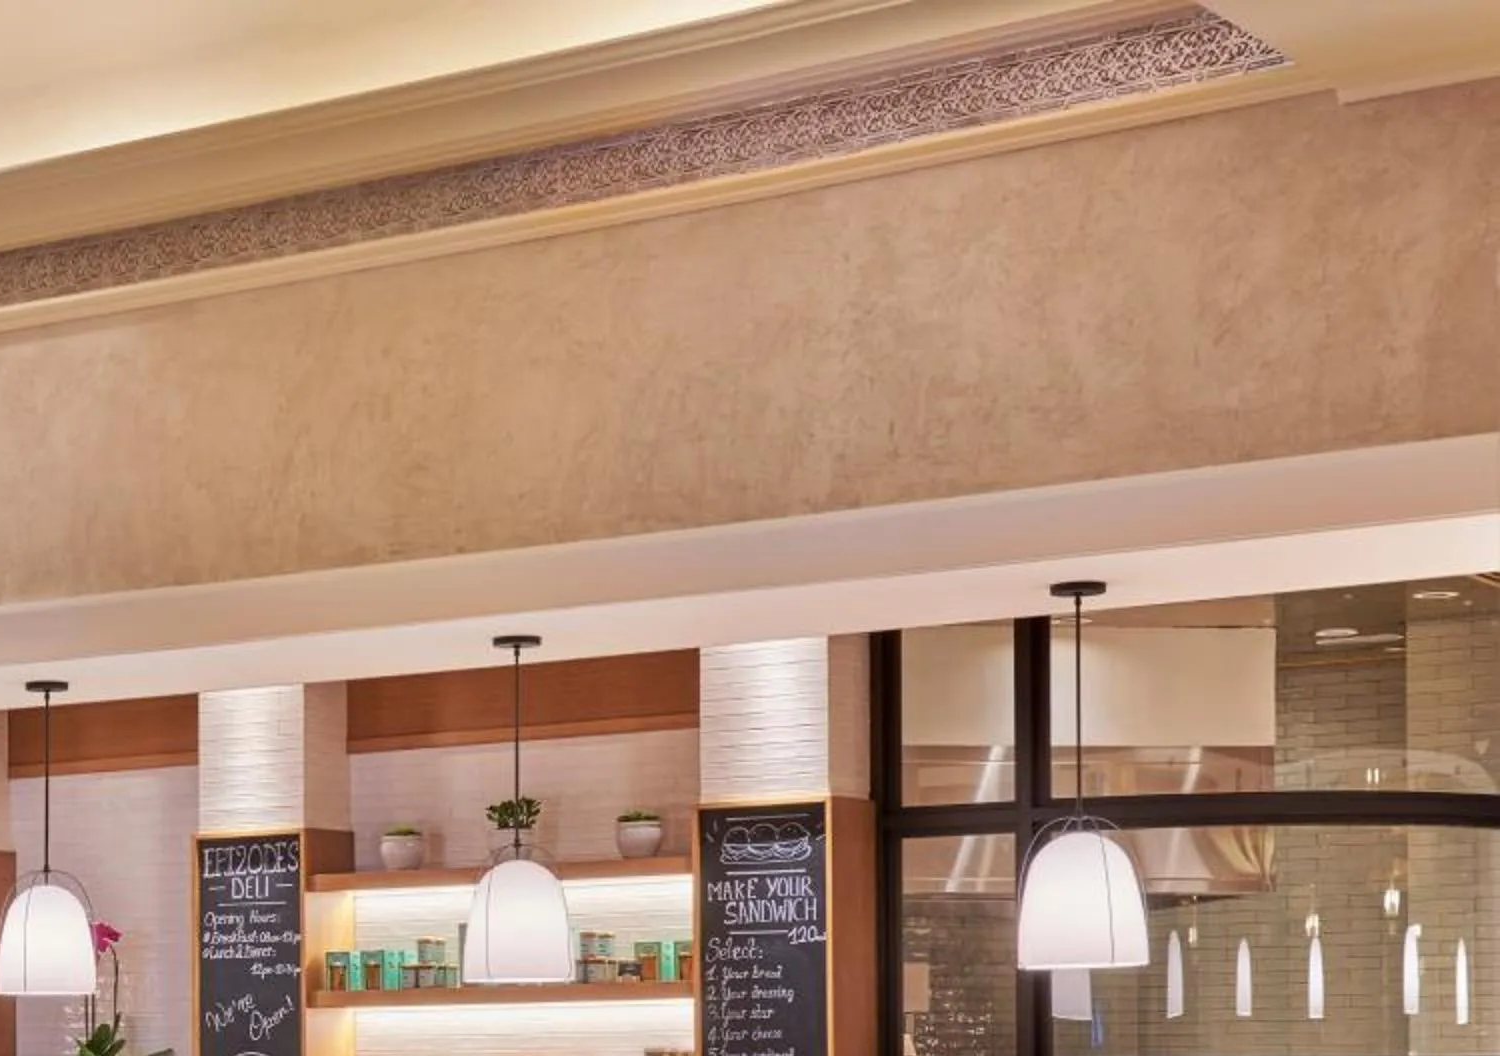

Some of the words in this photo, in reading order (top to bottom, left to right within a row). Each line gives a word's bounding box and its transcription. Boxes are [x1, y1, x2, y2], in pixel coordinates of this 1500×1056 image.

[231, 875, 269, 899] DELI
[707, 877, 759, 902] MAKE
[765, 876, 815, 899] YOUR
[724, 898, 817, 925] SANDWICH
